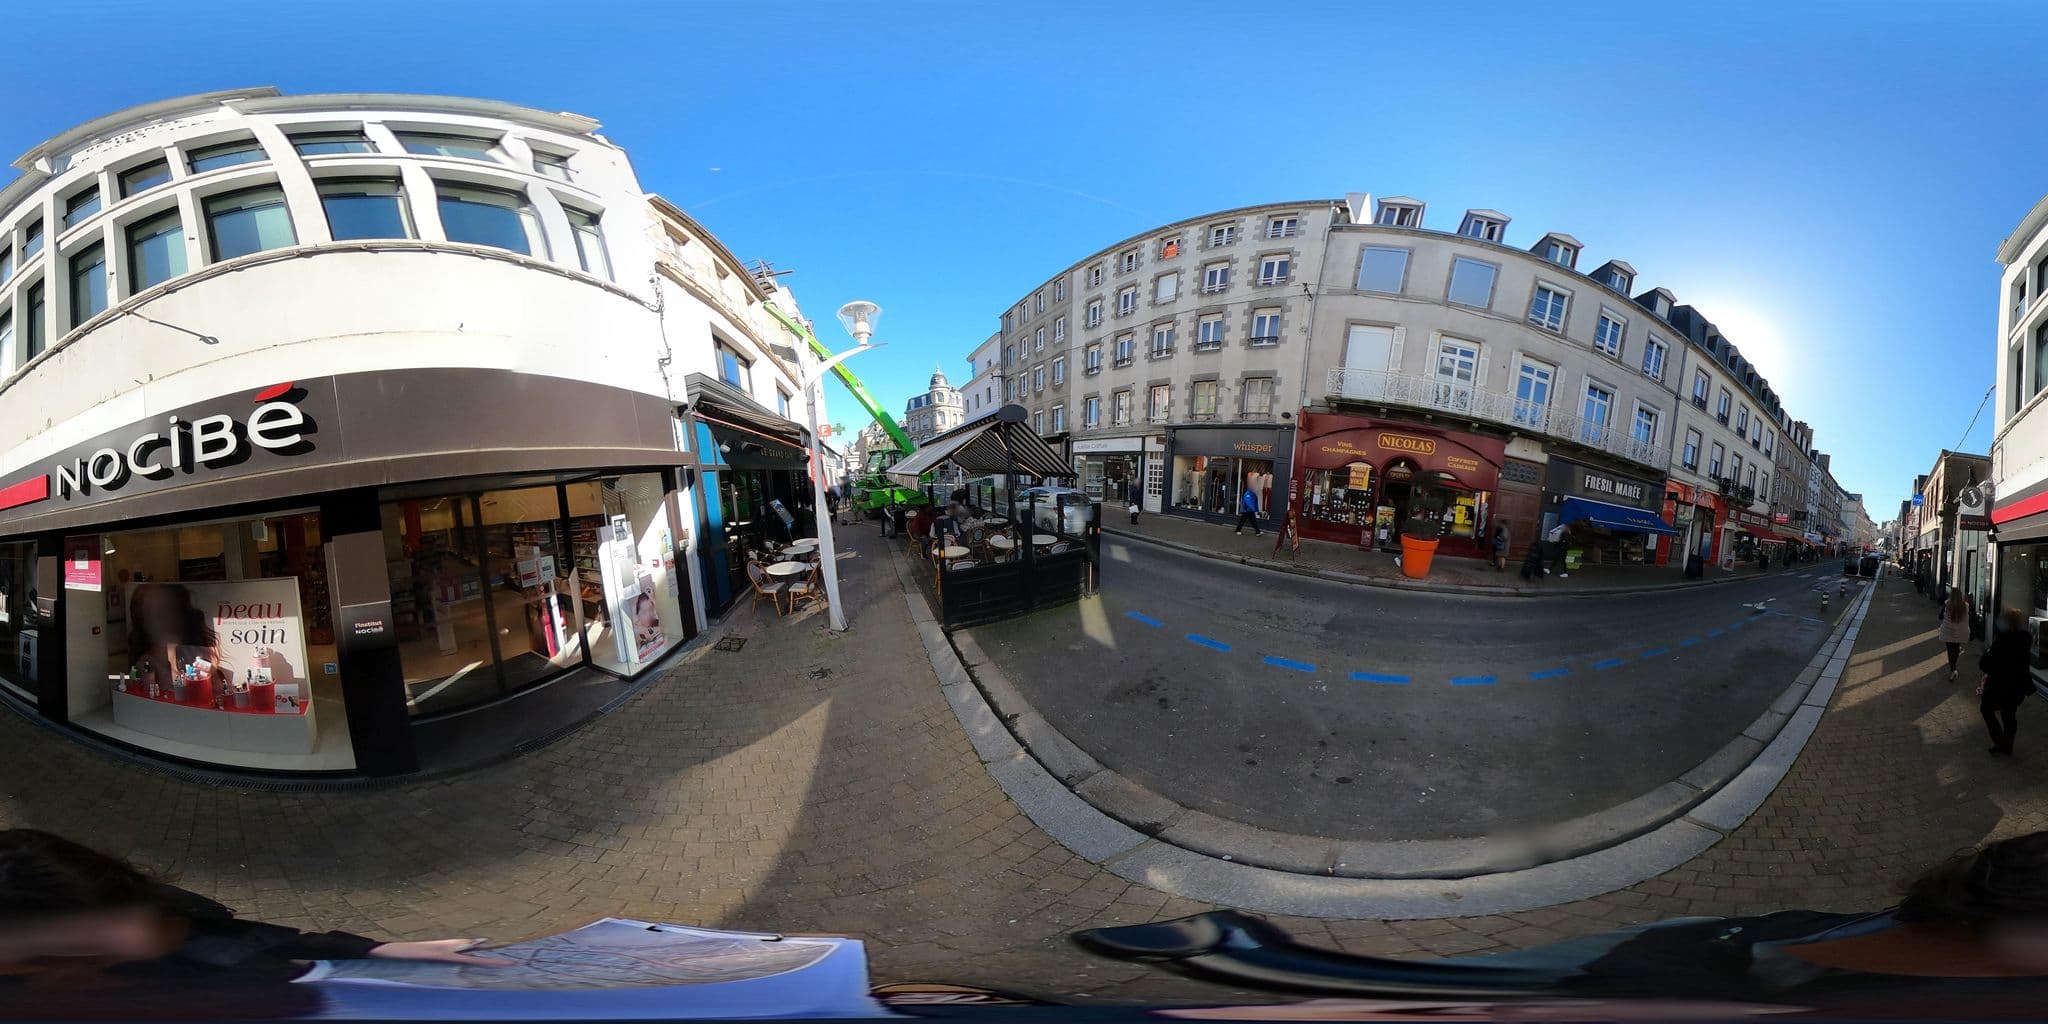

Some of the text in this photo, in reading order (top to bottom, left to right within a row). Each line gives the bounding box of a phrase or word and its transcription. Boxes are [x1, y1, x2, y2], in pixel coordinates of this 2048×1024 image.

[1233, 440, 1273, 453] whisper
[1321, 446, 1367, 456] CHAMPAGNES
[1337, 440, 1353, 448] VINS
[1381, 435, 1432, 453] NICOLAS
[1585, 474, 1641, 499] FRESIL MARÉE
[217, 602, 283, 626] peau
[230, 625, 288, 645] soin
